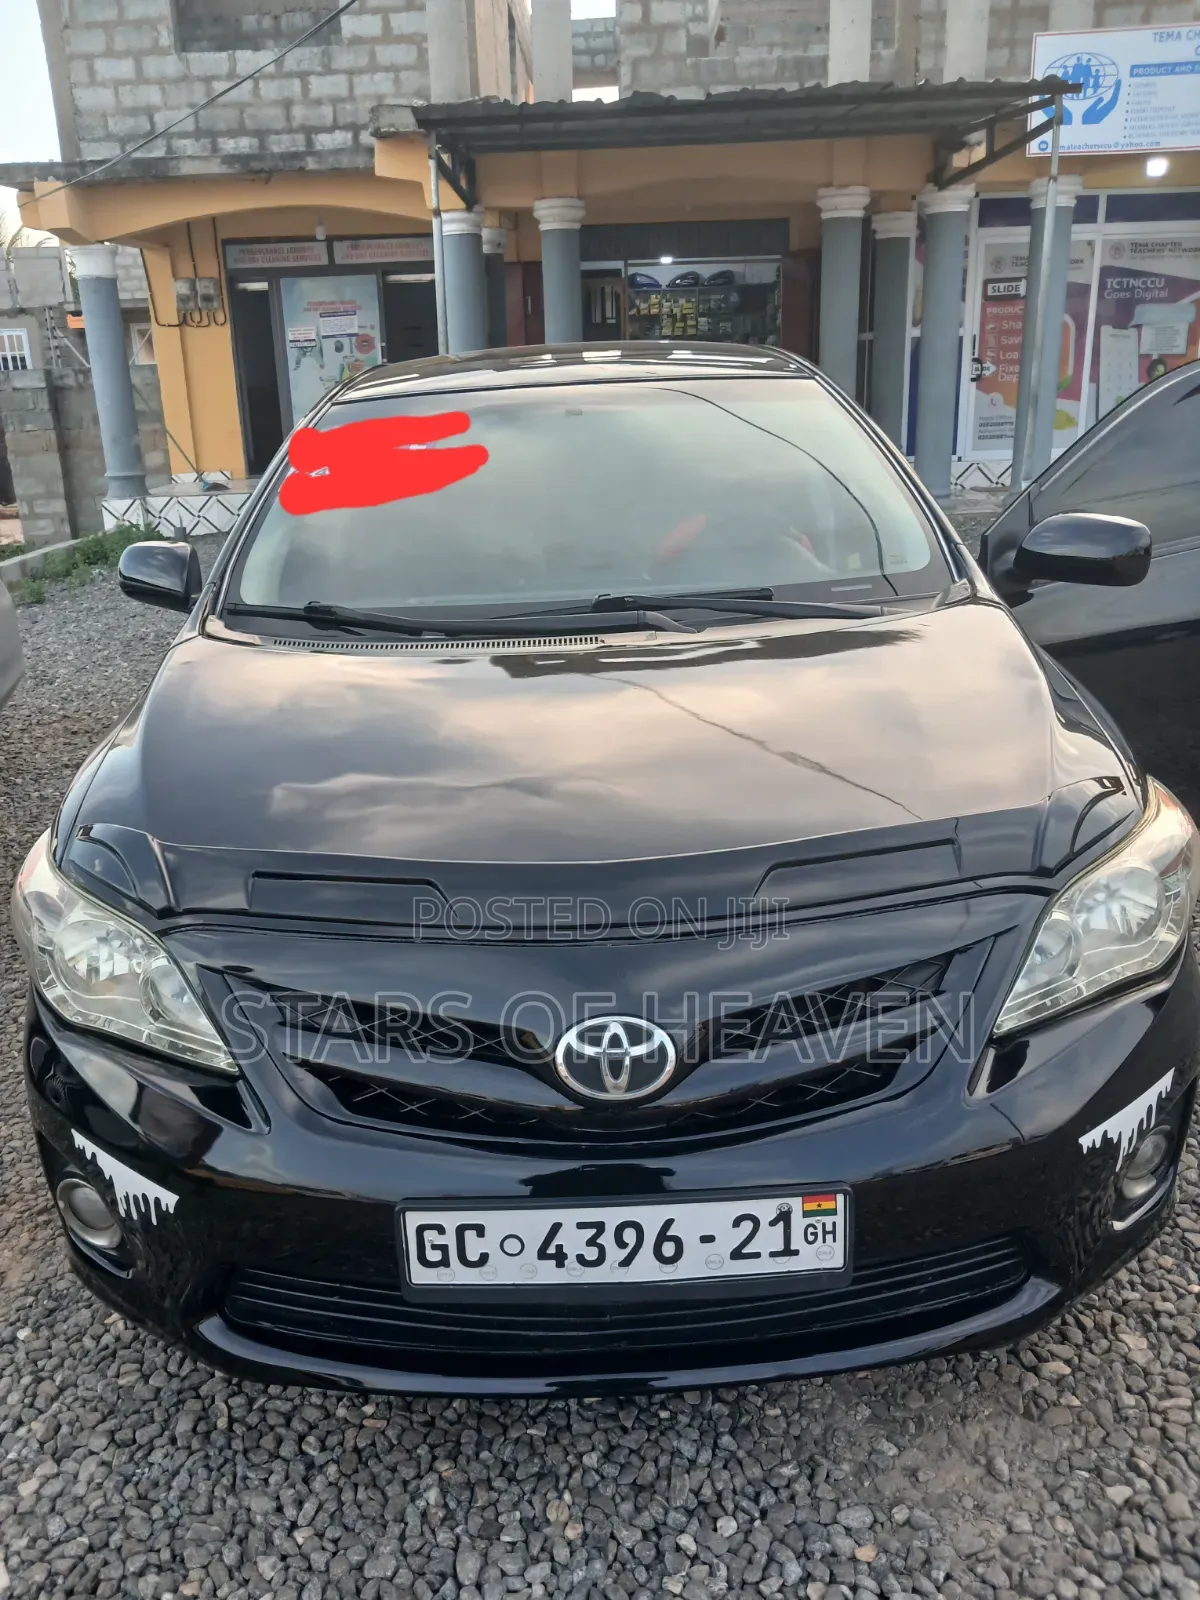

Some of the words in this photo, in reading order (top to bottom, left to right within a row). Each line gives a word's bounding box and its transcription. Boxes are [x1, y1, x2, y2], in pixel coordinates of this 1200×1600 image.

[1153, 31, 1182, 43] TEMA
[1133, 66, 1172, 76] PRODUCT
[1174, 64, 1192, 73] AND
[991, 284, 1021, 294] SLIDE
[1106, 277, 1165, 289] TCTNCCU
[1104, 289, 1130, 299] Goes
[1135, 288, 1168, 300] Digital
[803, 1221, 837, 1245] GH
[415, 1223, 490, 1268] GC
